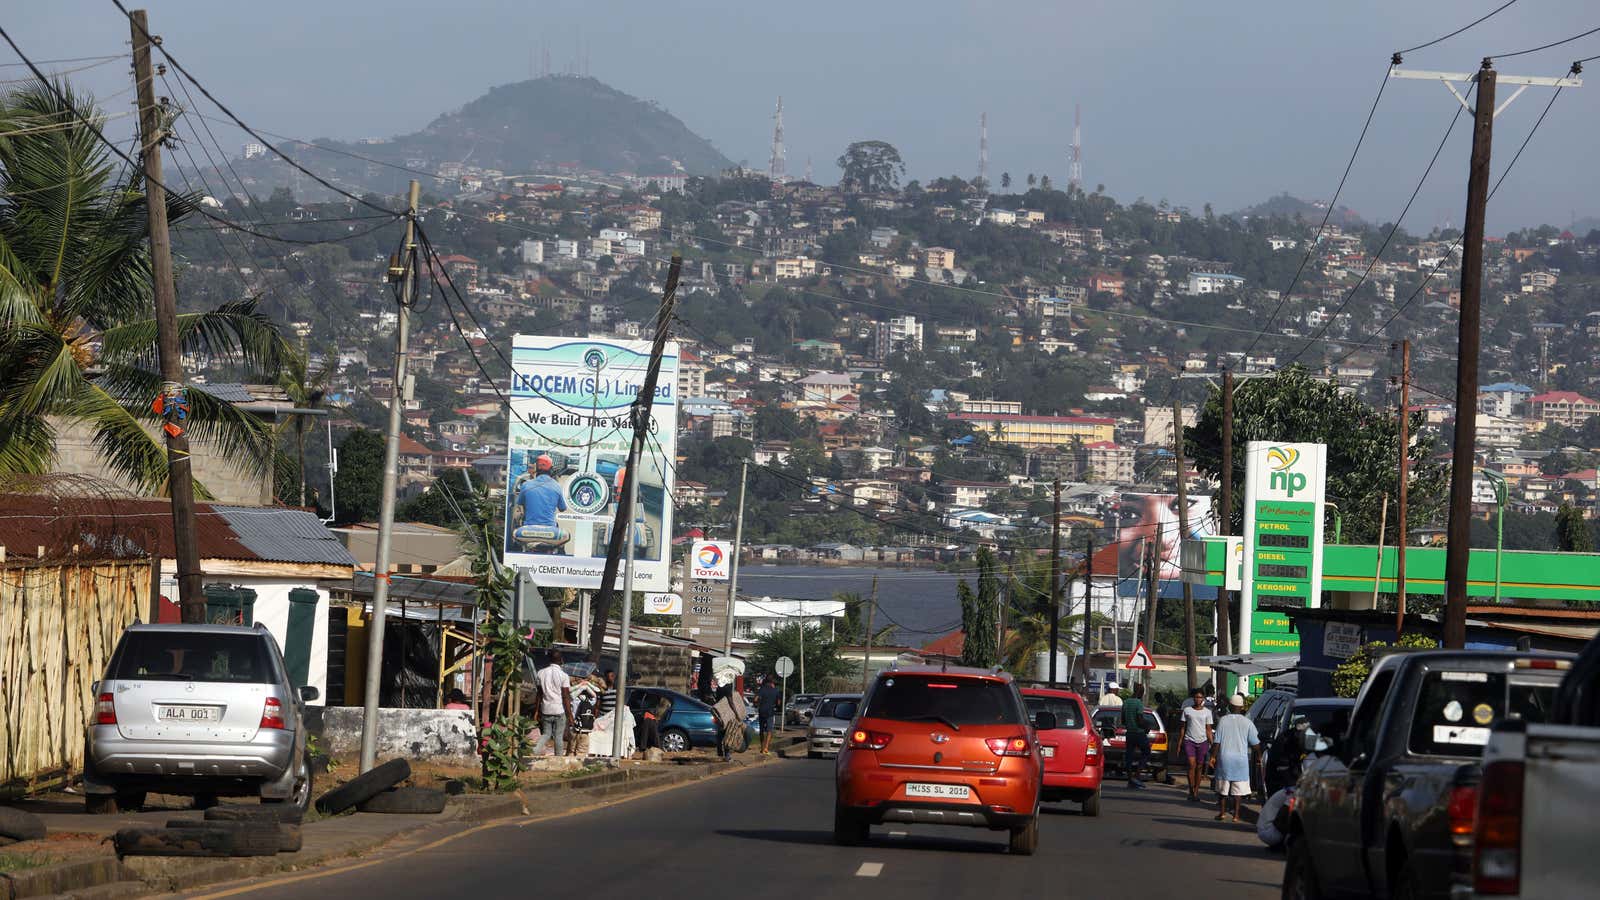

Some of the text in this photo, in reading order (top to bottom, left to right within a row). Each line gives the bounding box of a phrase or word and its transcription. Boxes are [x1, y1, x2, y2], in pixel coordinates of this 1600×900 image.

[513, 374, 576, 394] LEOCEM
[528, 412, 547, 425] We
[551, 414, 581, 427] Build
[1270, 471, 1307, 498] np
[1259, 523, 1290, 531] PETROL
[1258, 552, 1286, 561] DIESEL
[538, 565, 566, 575] CEMENT
[1256, 584, 1297, 592] KEROSINE
[1263, 618, 1275, 626] NP
[166, 707, 186, 719] ALA
[911, 785, 969, 796] MISS SL 2016
